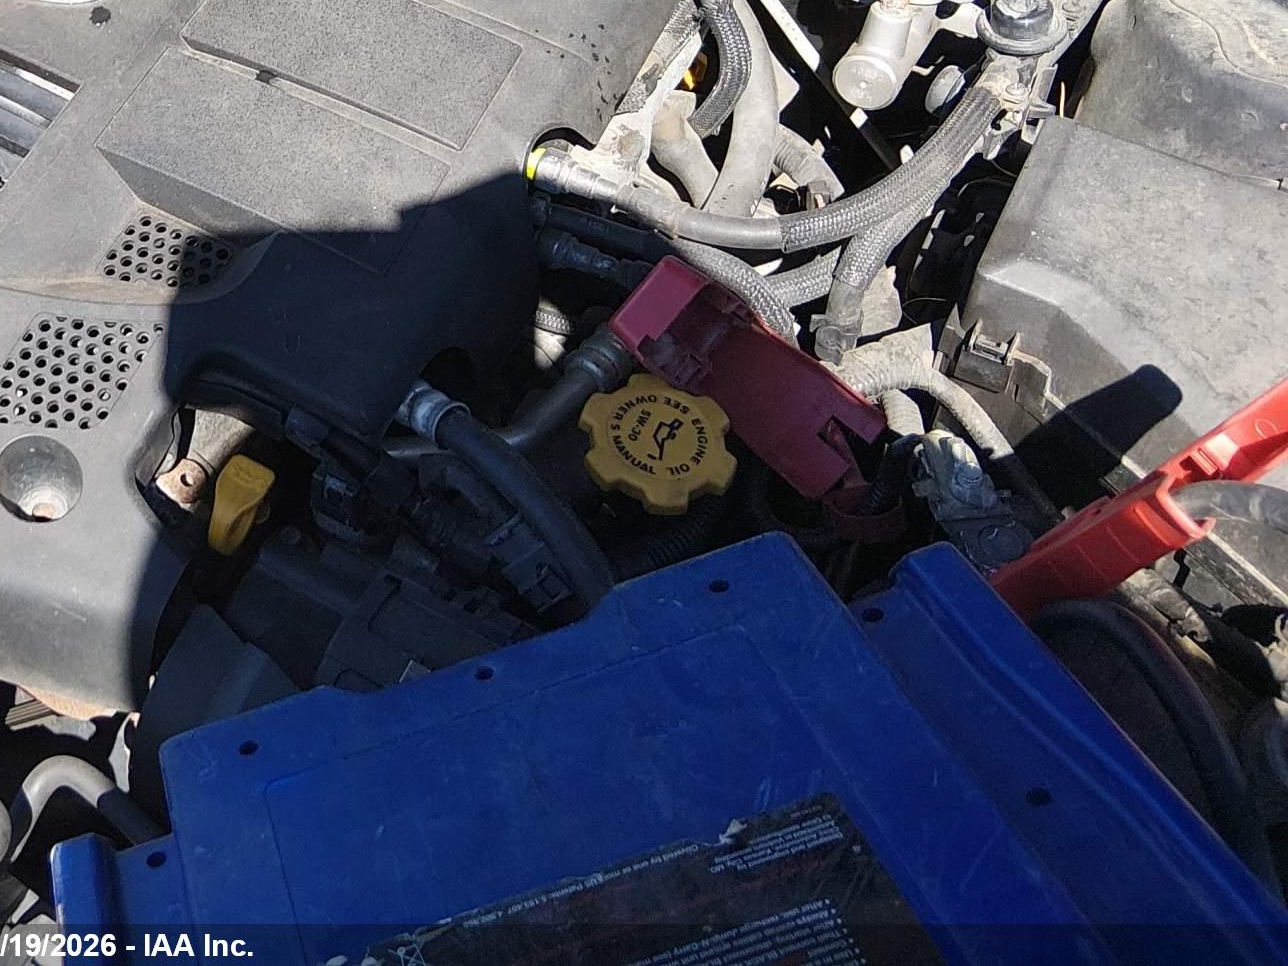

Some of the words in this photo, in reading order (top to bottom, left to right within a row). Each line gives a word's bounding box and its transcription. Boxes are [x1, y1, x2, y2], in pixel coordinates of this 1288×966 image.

[663, 396, 690, 414] SEE
[627, 409, 652, 442] 5W-30
[690, 417, 709, 466] ENGINE
[612, 435, 657, 475] MANUAL
[665, 463, 691, 476] OIL
